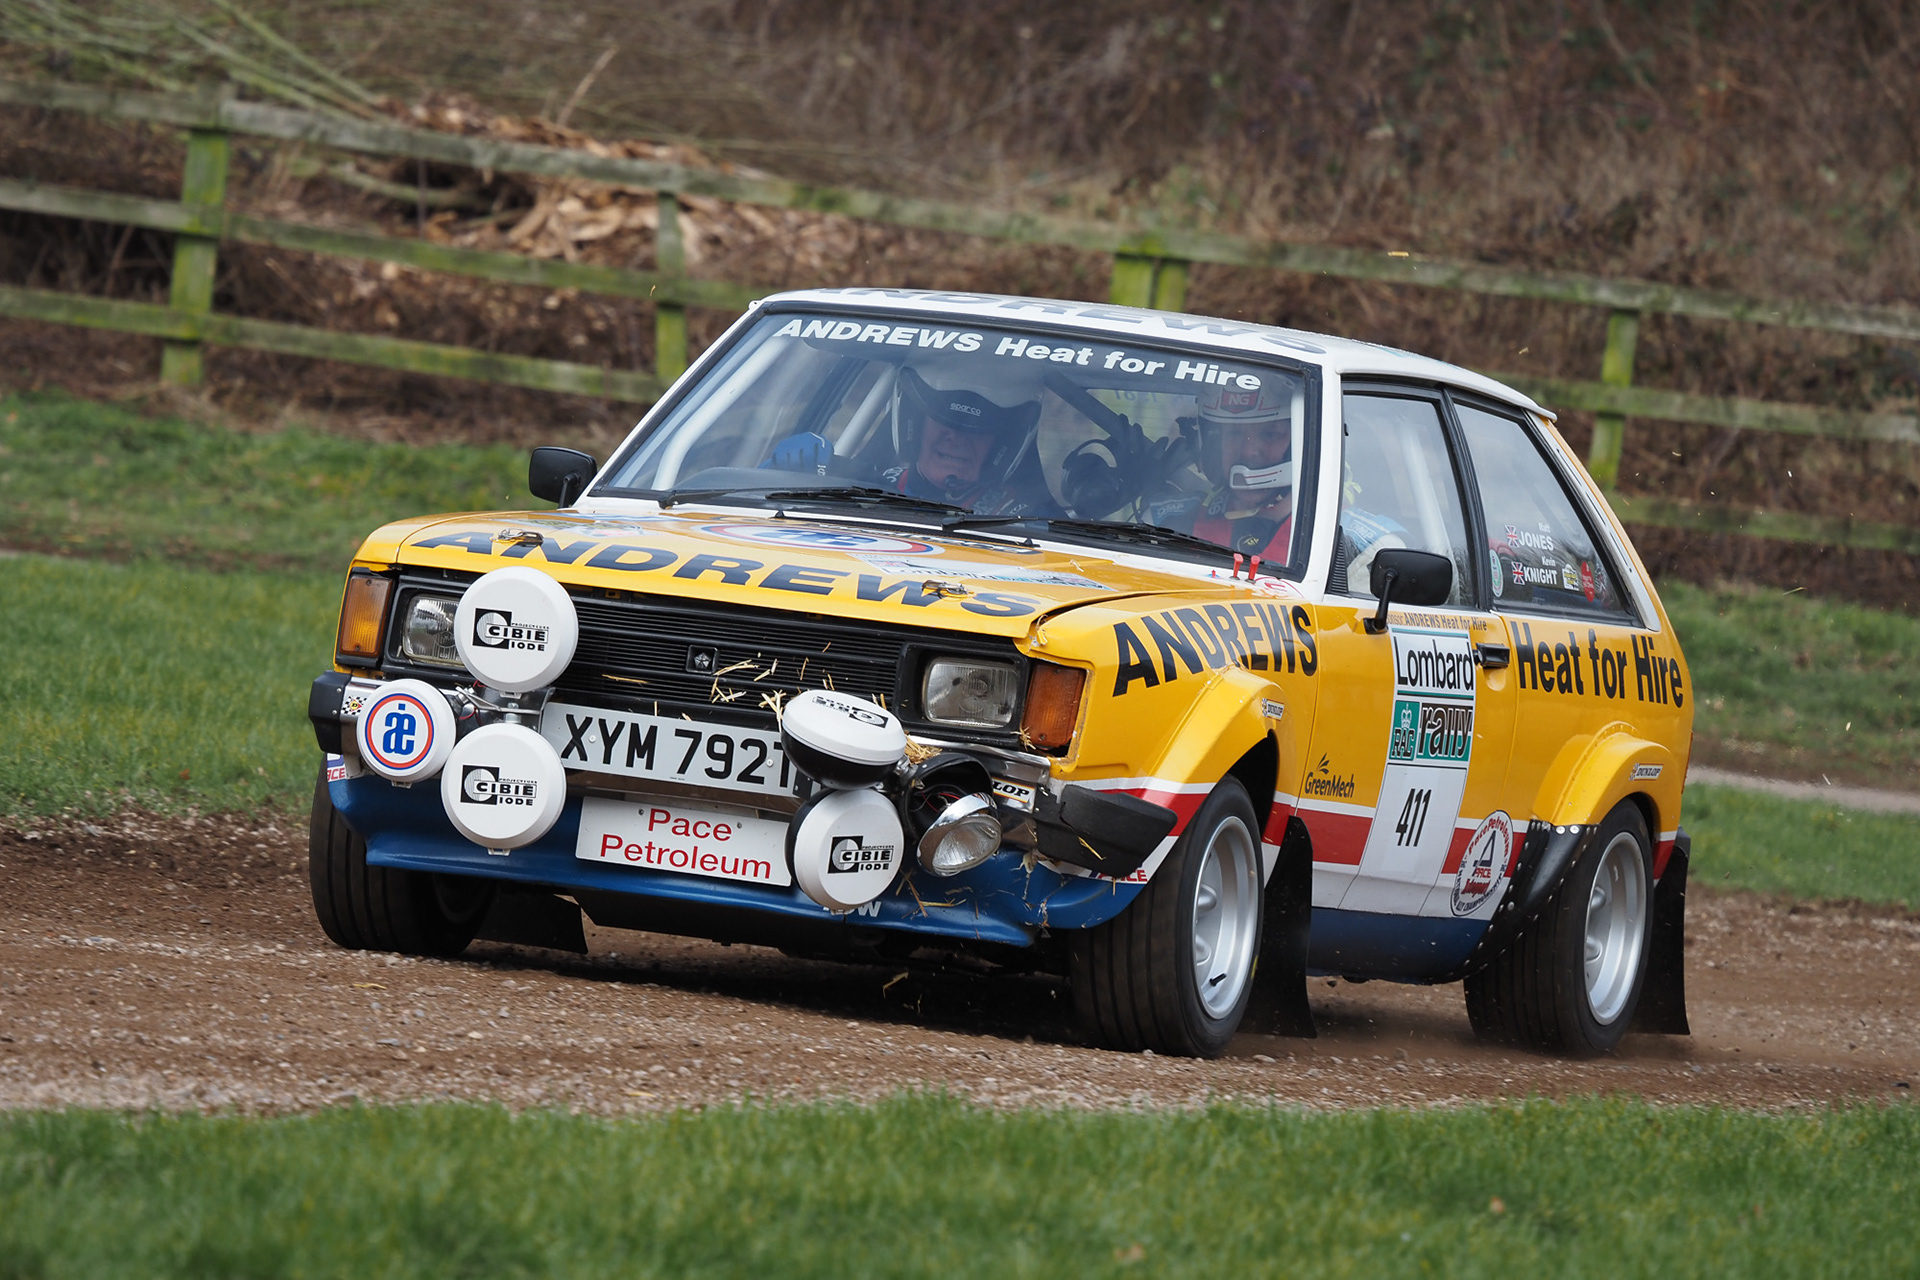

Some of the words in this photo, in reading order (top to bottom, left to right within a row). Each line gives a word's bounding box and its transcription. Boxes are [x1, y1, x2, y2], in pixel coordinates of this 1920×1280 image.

[773, 319, 983, 352] ANDREWS
[995, 336, 1094, 366] Heat
[1104, 351, 1165, 375] for
[1174, 360, 1262, 390] Hire
[1519, 531, 1554, 551] JONES
[411, 531, 1041, 618] ANDREWS
[1523, 566, 1558, 585] KNIGHT
[488, 626, 546, 641] CIBIE
[1404, 612, 1440, 628] ANDREWS
[1441, 615, 1458, 629] Heat
[1460, 616, 1470, 630] for
[1471, 617, 1487, 631] Hire
[511, 641, 545, 652] IODE
[1112, 603, 1317, 697] ANDREWS
[1393, 636, 1474, 690] Lombard
[1510, 621, 1585, 696] Heat
[1588, 629, 1627, 699] for
[1631, 634, 1684, 708] Hire
[1391, 727, 1415, 758] RAC
[1418, 706, 1473, 758] rally
[561, 714, 658, 770] XYM
[674, 728, 791, 788] 792T
[476, 782, 533, 796] CIBIE
[1305, 772, 1355, 798] GreenMech
[500, 797, 533, 806] IODE
[648, 808, 733, 841] Pace
[1395, 788, 1432, 848] 411
[600, 834, 772, 879] Petroleum
[842, 850, 891, 861] CIBIE
[860, 863, 889, 871] IODE
